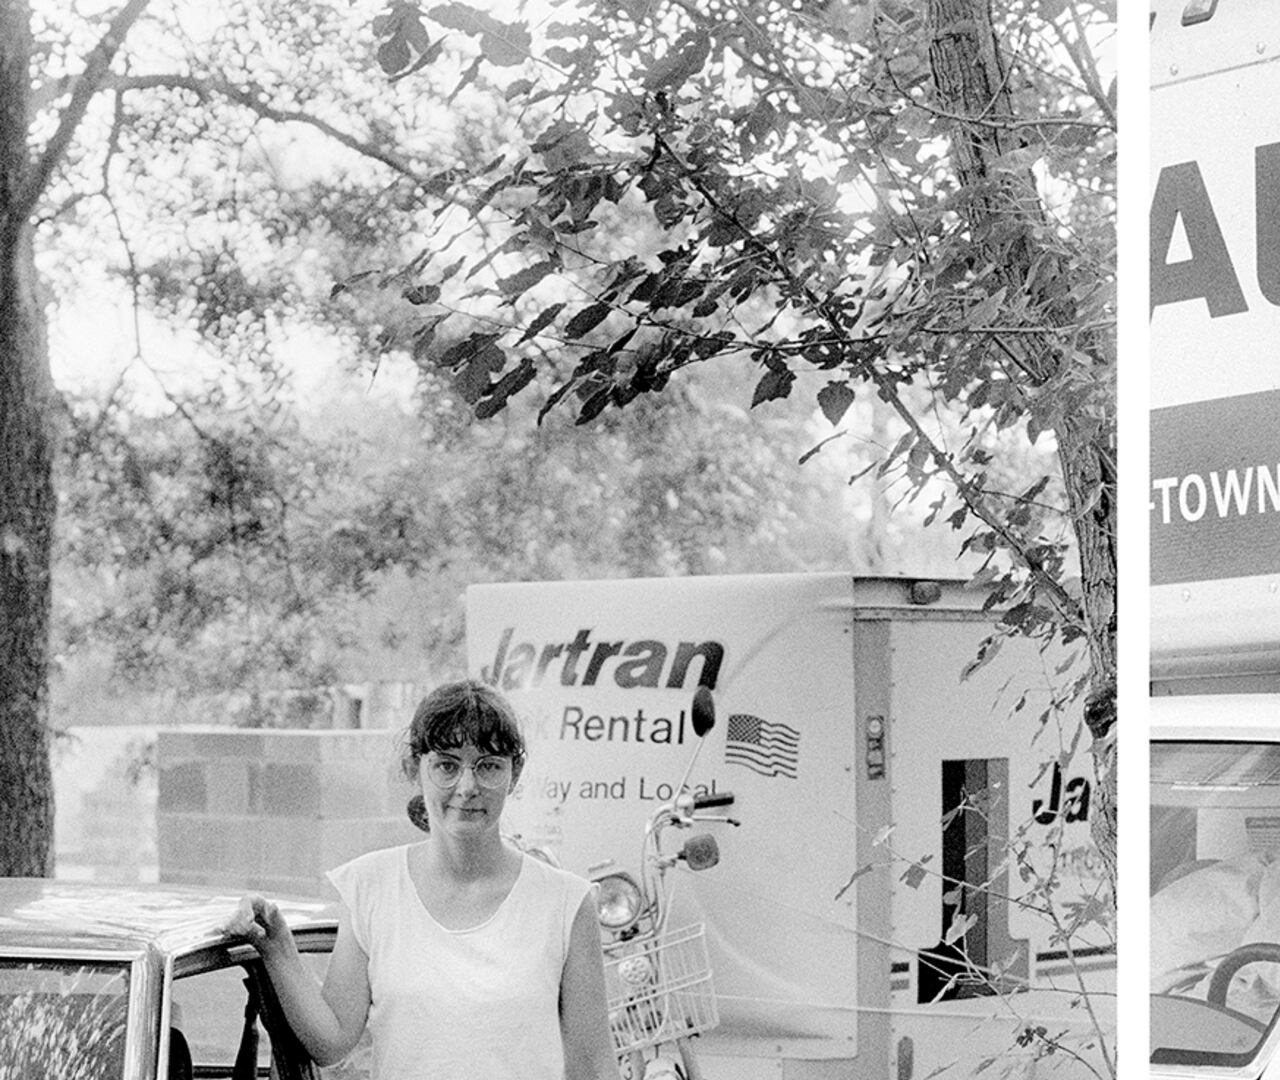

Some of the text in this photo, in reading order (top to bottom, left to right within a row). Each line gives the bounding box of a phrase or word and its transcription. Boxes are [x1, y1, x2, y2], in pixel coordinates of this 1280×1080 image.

[481, 627, 725, 691] Jartran
[559, 705, 686, 745] Rental
[579, 776, 626, 800] and
